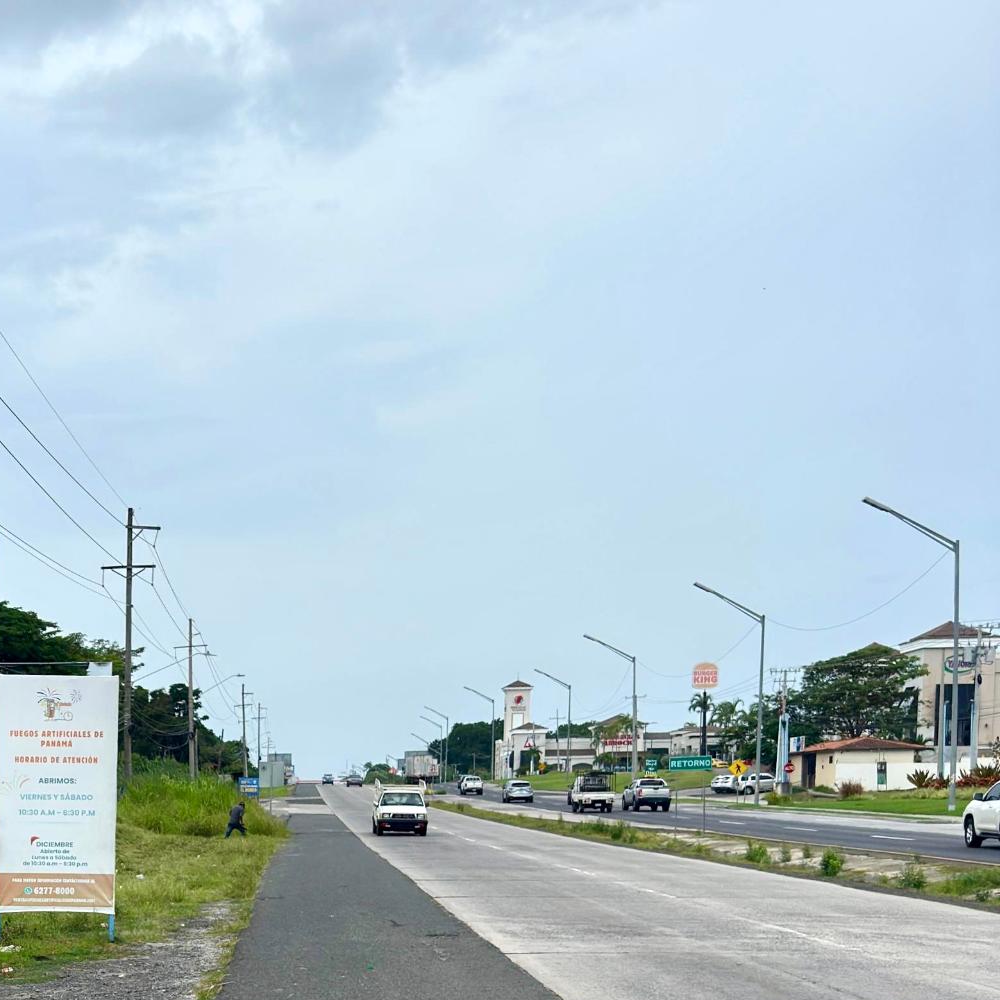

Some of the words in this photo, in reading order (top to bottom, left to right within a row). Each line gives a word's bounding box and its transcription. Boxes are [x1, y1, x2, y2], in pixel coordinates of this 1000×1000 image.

[693, 676, 718, 684] KING
[9, 730, 39, 738] FUEGOS
[62, 755, 98, 764] ATENCIÓN
[670, 759, 711, 768] RETORNO
[38, 777, 77, 785] ABRIMOS:
[60, 792, 93, 801] SÁBADO
[18, 808, 39, 816] 10:30
